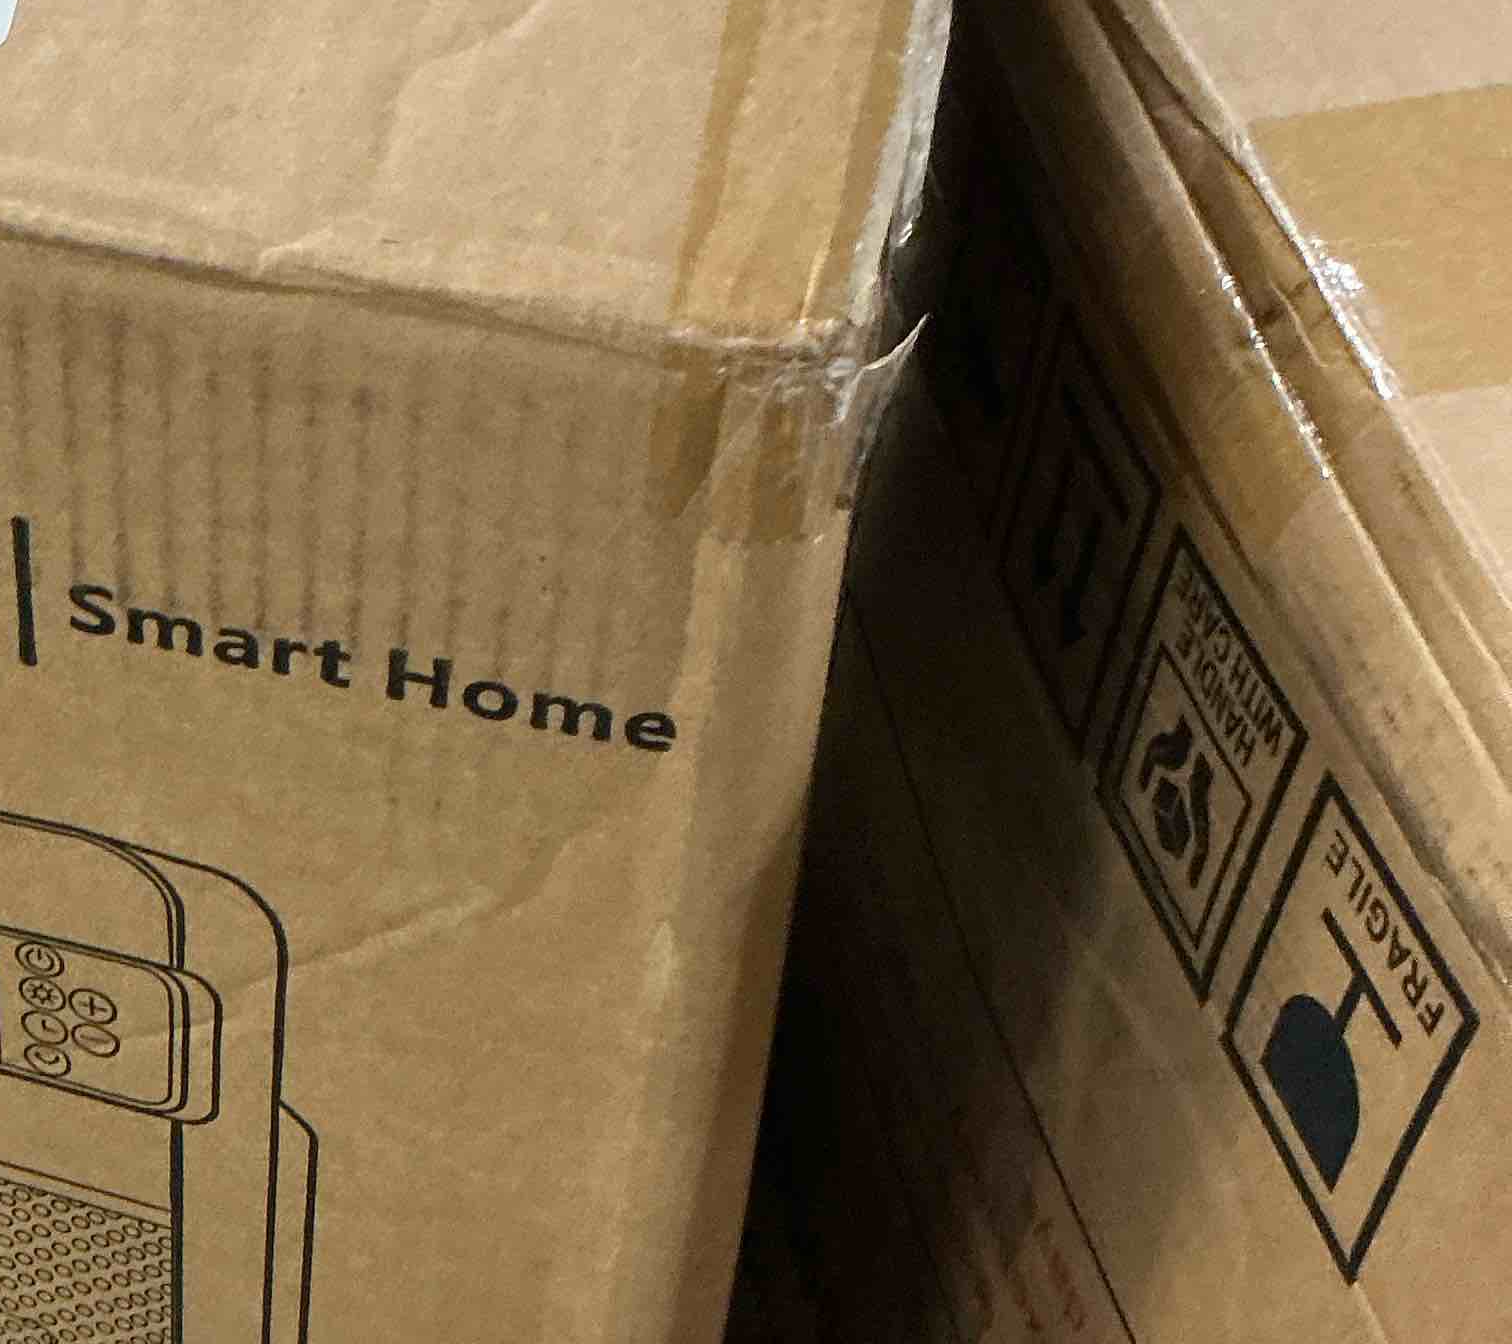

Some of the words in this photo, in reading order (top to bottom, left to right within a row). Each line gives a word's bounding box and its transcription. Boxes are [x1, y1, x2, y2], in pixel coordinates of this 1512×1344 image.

[68, 583, 352, 689] Smart
[387, 648, 677, 753] Home
[1176, 627, 1256, 766] HANDLE
[1229, 668, 1283, 756] WITH
[1325, 828, 1445, 1037] FRAGILE
